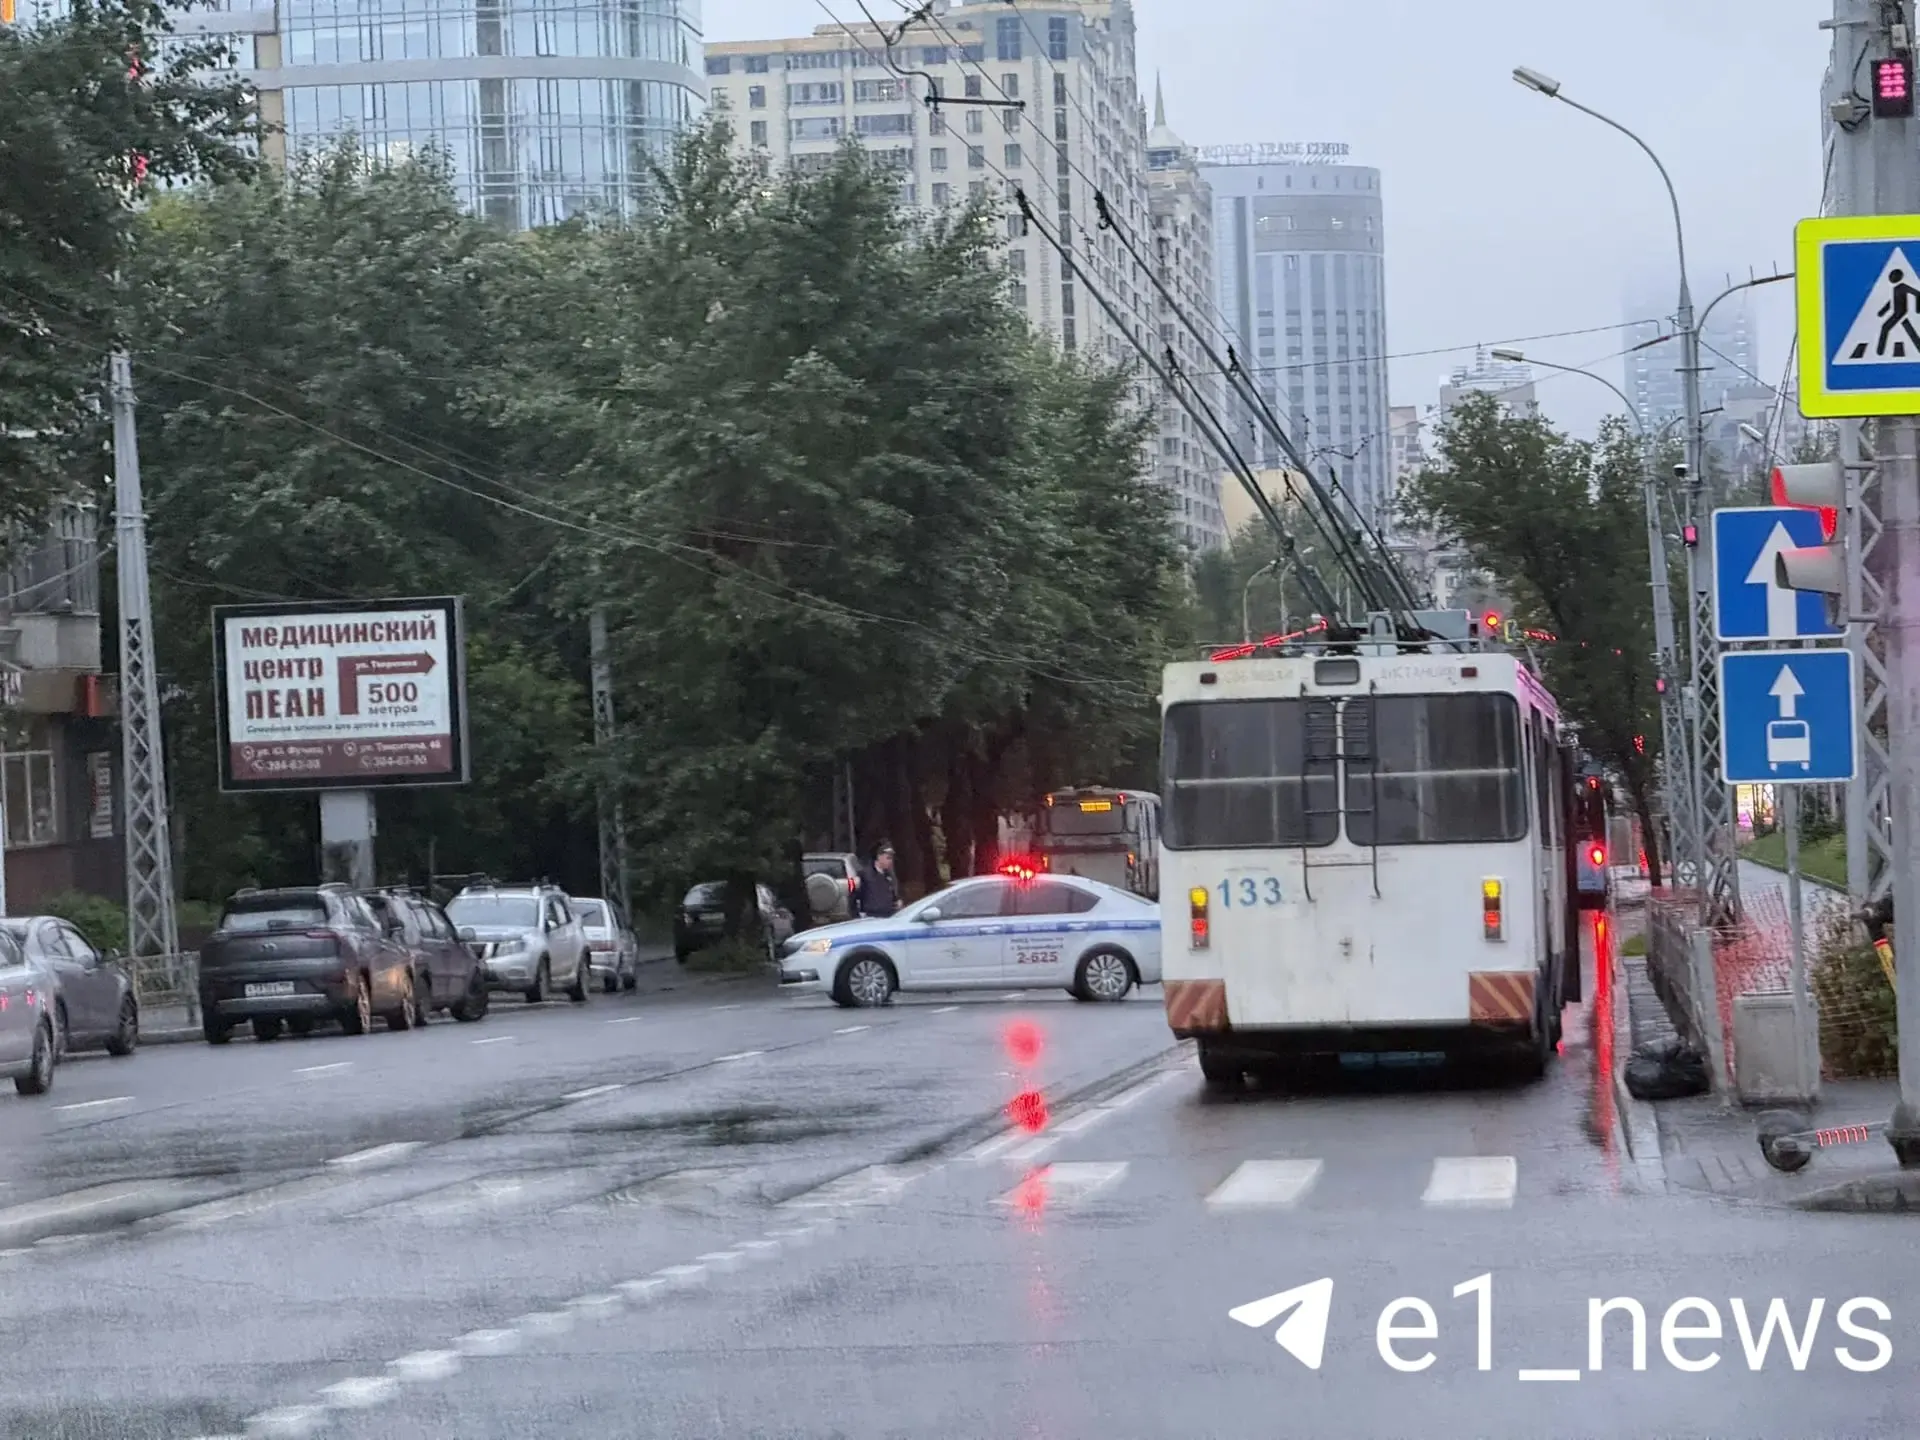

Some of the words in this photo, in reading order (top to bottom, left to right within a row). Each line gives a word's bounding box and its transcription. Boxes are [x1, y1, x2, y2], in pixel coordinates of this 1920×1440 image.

[246, 688, 325, 719] ПЕАН
[368, 682, 418, 704] 500
[368, 705, 418, 718] метров
[1216, 877, 1282, 908] 133
